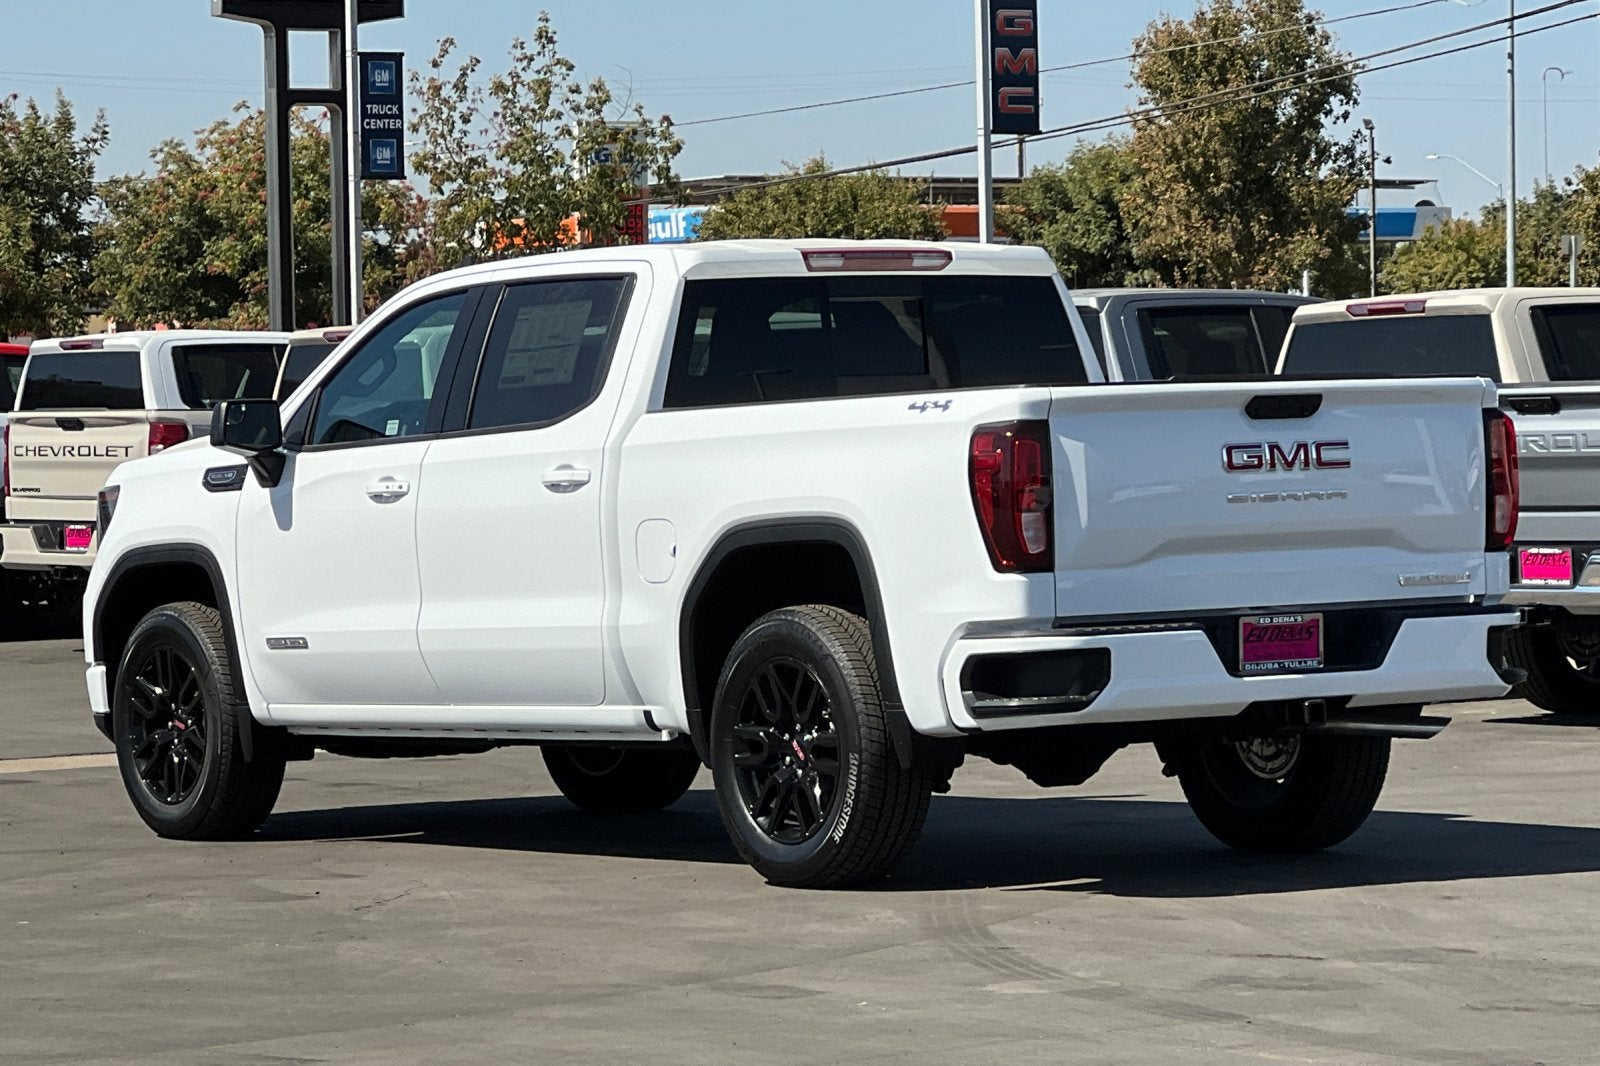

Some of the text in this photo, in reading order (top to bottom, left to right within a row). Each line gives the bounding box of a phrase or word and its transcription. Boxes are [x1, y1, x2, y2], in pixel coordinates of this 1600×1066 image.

[995, 9, 1036, 114] GMC
[374, 69, 389, 82] GM
[366, 104, 399, 115] TRUCK
[363, 118, 402, 129] CENTER
[376, 147, 391, 160] GM
[14, 445, 133, 458] CHEVROLET
[1222, 440, 1350, 473] GMC
[1226, 489, 1348, 504] SIERRA
[832, 752, 859, 844] BRIDGESTONE
